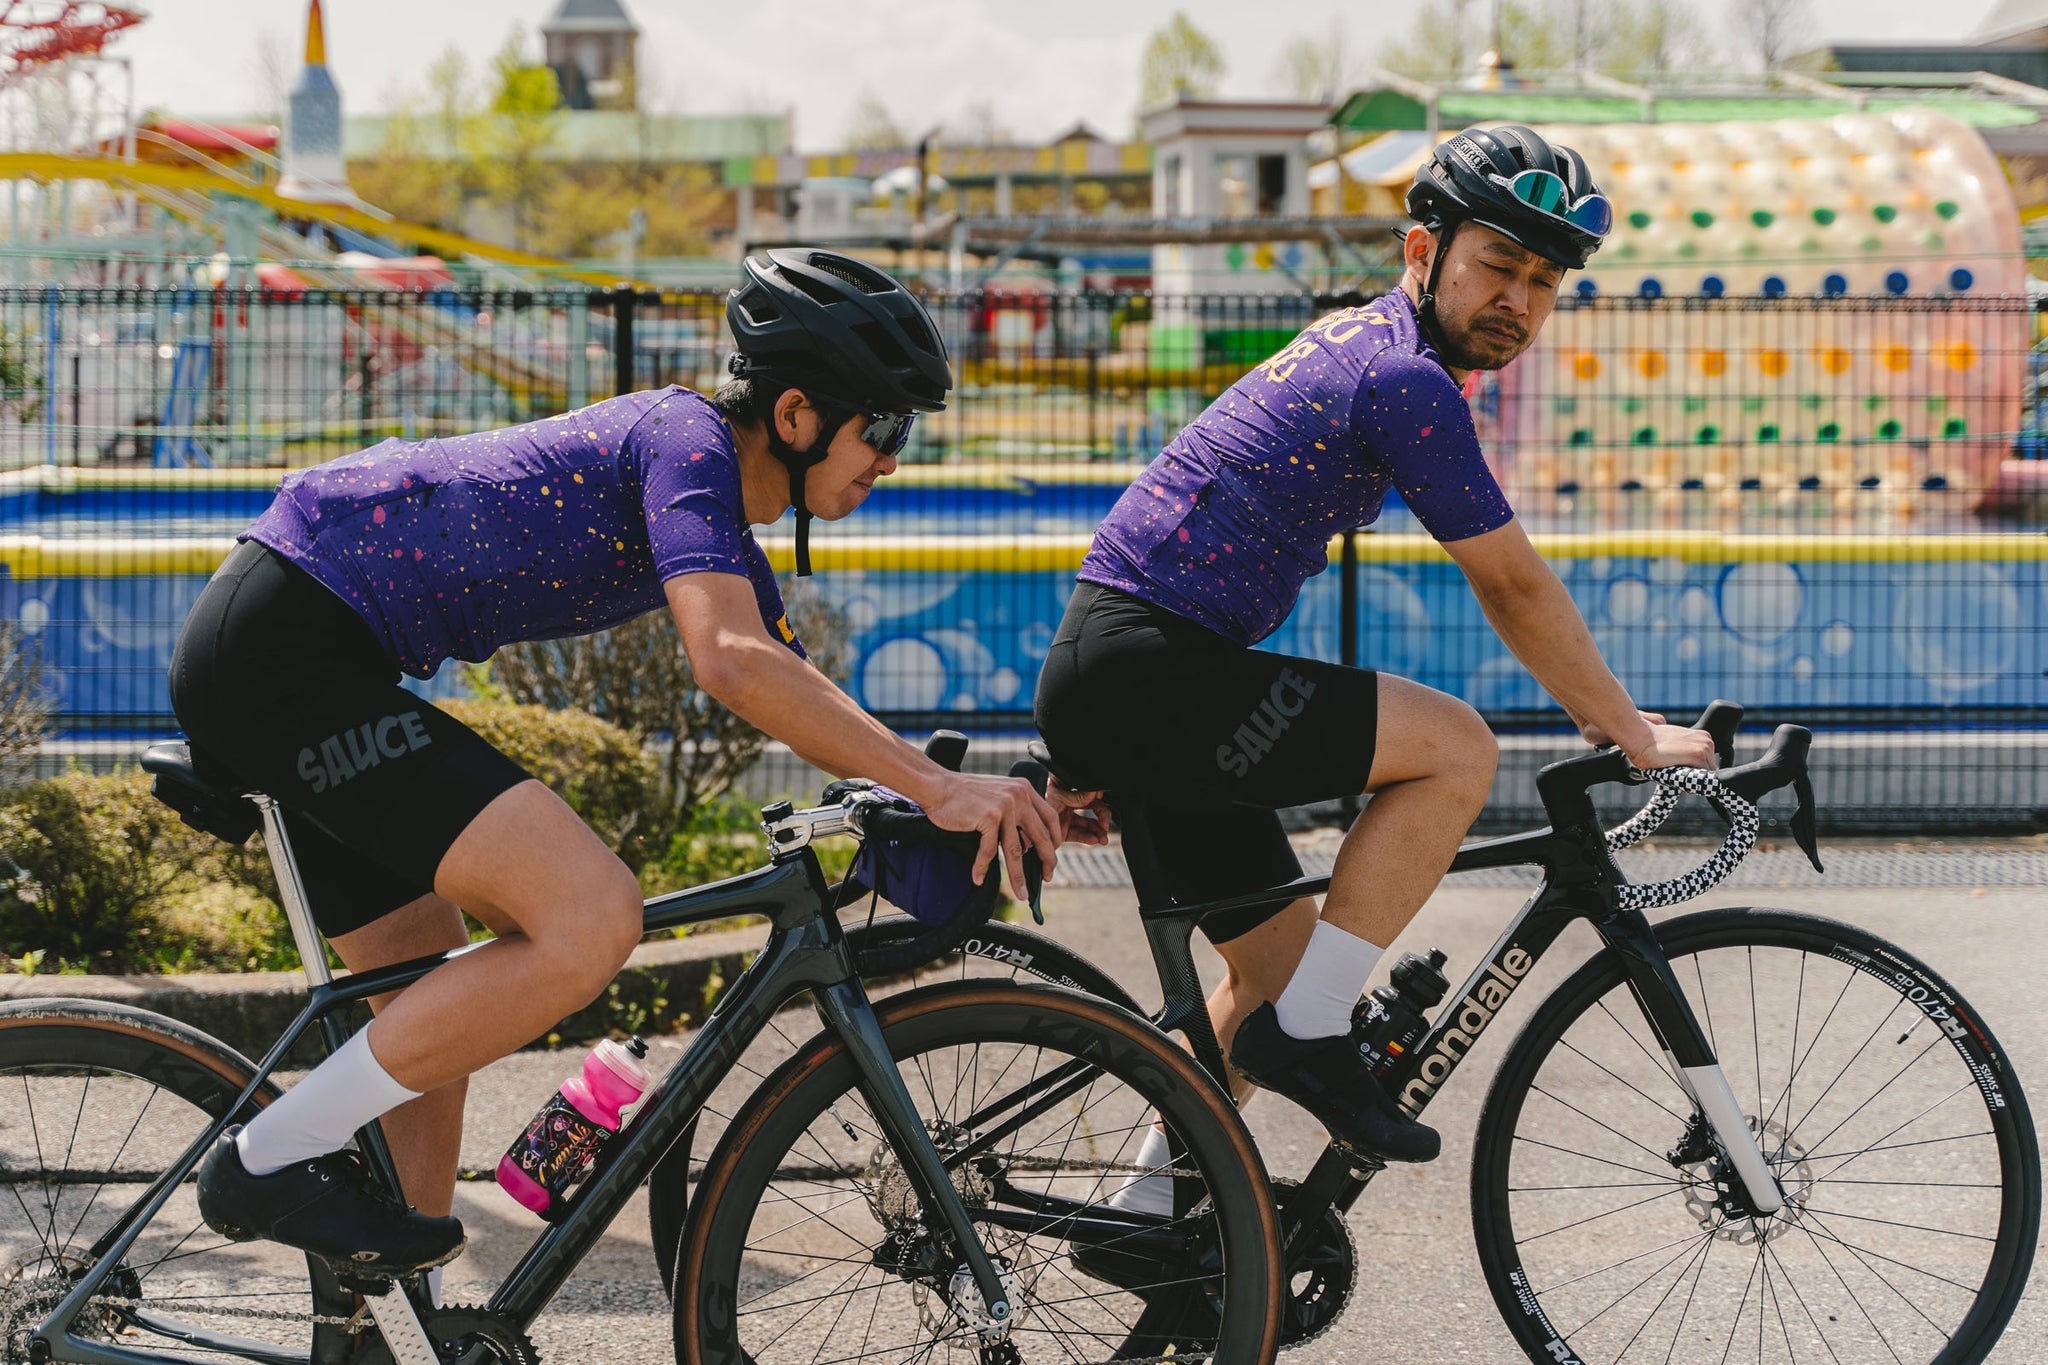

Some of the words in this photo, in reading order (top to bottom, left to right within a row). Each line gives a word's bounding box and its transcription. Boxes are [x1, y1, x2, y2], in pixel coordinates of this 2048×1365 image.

[1459, 142, 1483, 167] GIRO
[1216, 666, 1317, 778] SAUCE
[297, 711, 432, 794] SAUCE
[965, 939, 1035, 970] R470
[1894, 972, 1915, 988] db
[1396, 943, 1533, 1121] nondale
[1907, 986, 1969, 1040] R470
[1978, 1063, 1999, 1091] SWISS
[1992, 1091, 2006, 1107] DT
[1509, 1271, 1522, 1287] DT
[1516, 1288, 1535, 1316] SWISS
